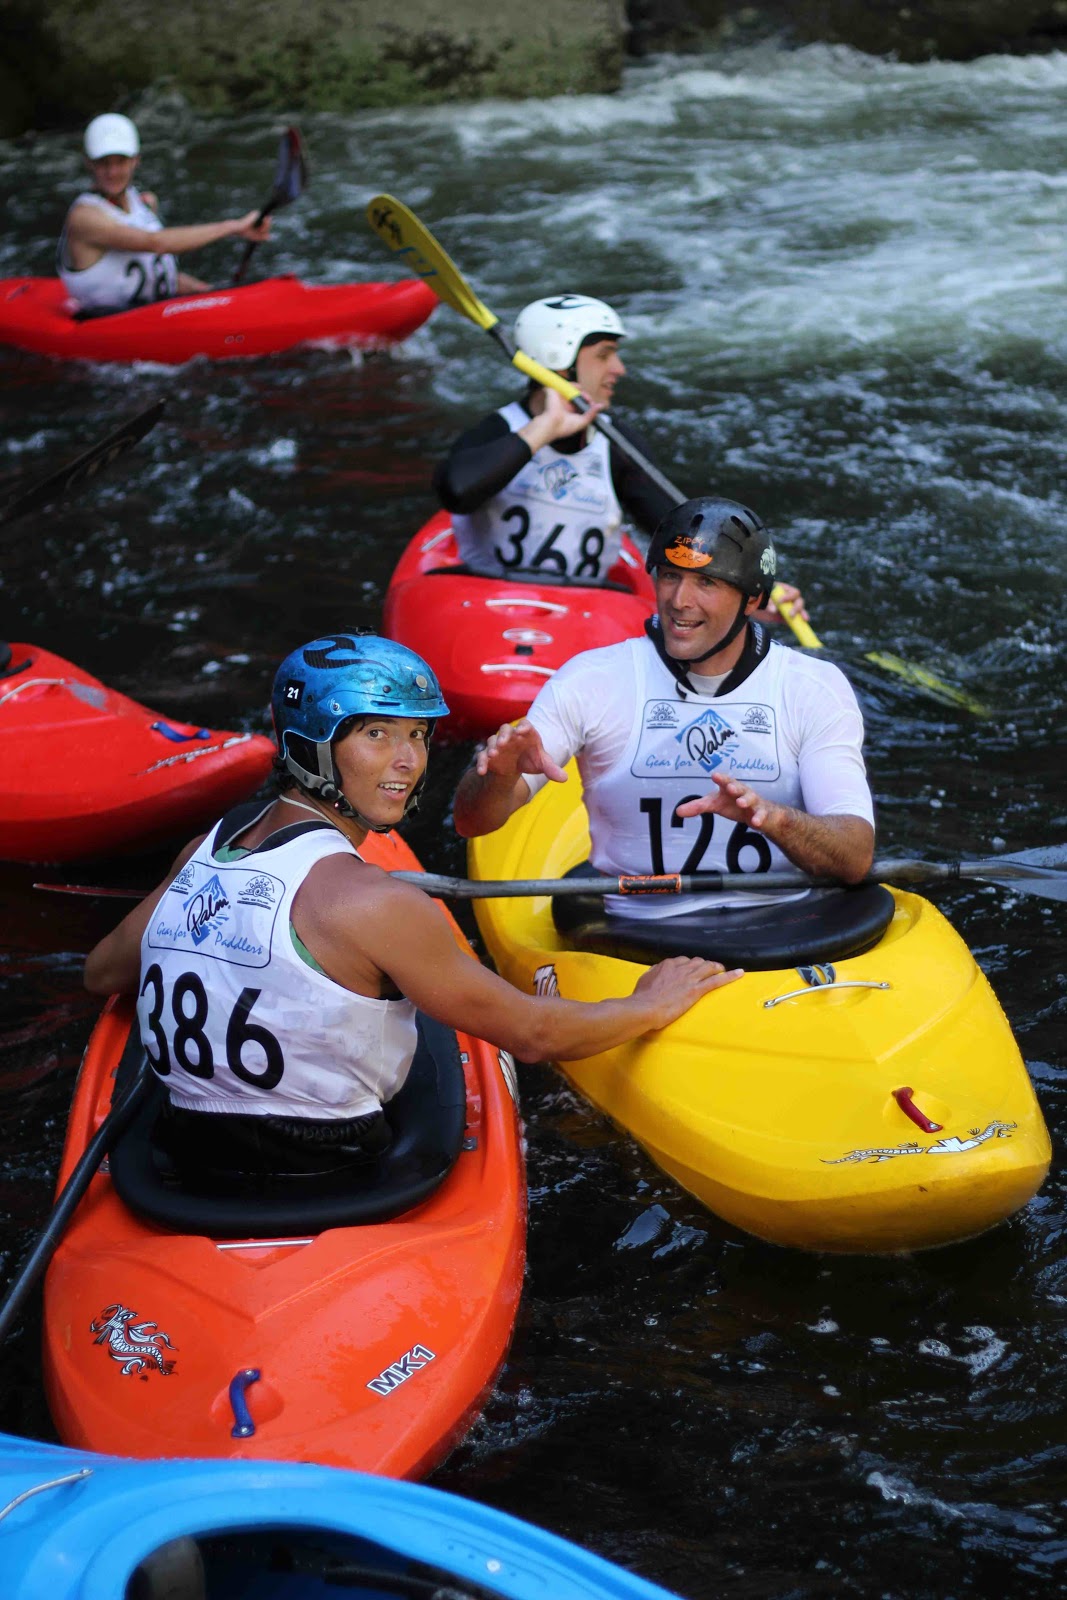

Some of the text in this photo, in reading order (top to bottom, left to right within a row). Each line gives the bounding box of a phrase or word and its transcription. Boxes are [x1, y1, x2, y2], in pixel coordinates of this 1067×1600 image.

[494, 505, 605, 577] 368
[287, 686, 300, 700] 21
[645, 754, 776, 771] Gear for Paddlers
[686, 726, 735, 765] Palm
[640, 794, 772, 874] 126
[187, 893, 230, 936] Palm
[156, 921, 264, 956] Gear for Paddlers
[140, 963, 285, 1090] 386
[366, 1344, 436, 1396] MK1
